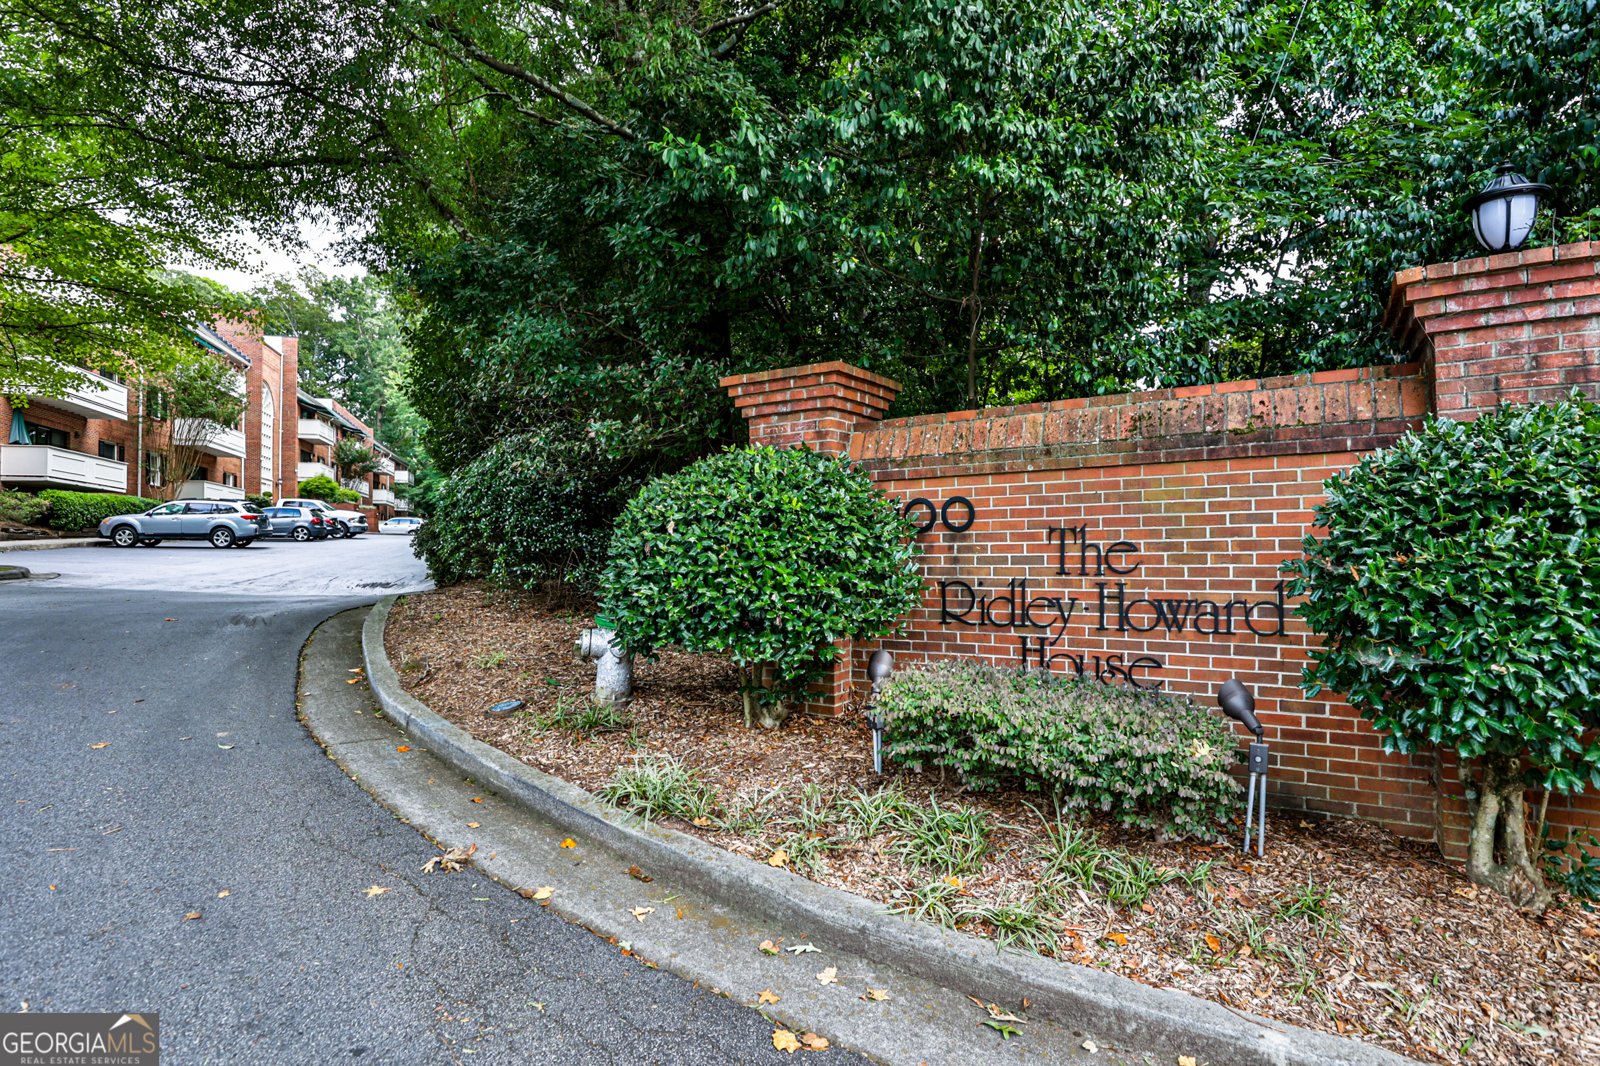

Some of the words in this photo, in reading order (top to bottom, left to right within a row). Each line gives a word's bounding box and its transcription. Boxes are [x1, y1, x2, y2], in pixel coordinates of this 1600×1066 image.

[1048, 523, 1140, 576] The
[938, 577, 1078, 646] Ridley
[1095, 579, 1289, 637] Howard
[1018, 635, 1165, 690] House
